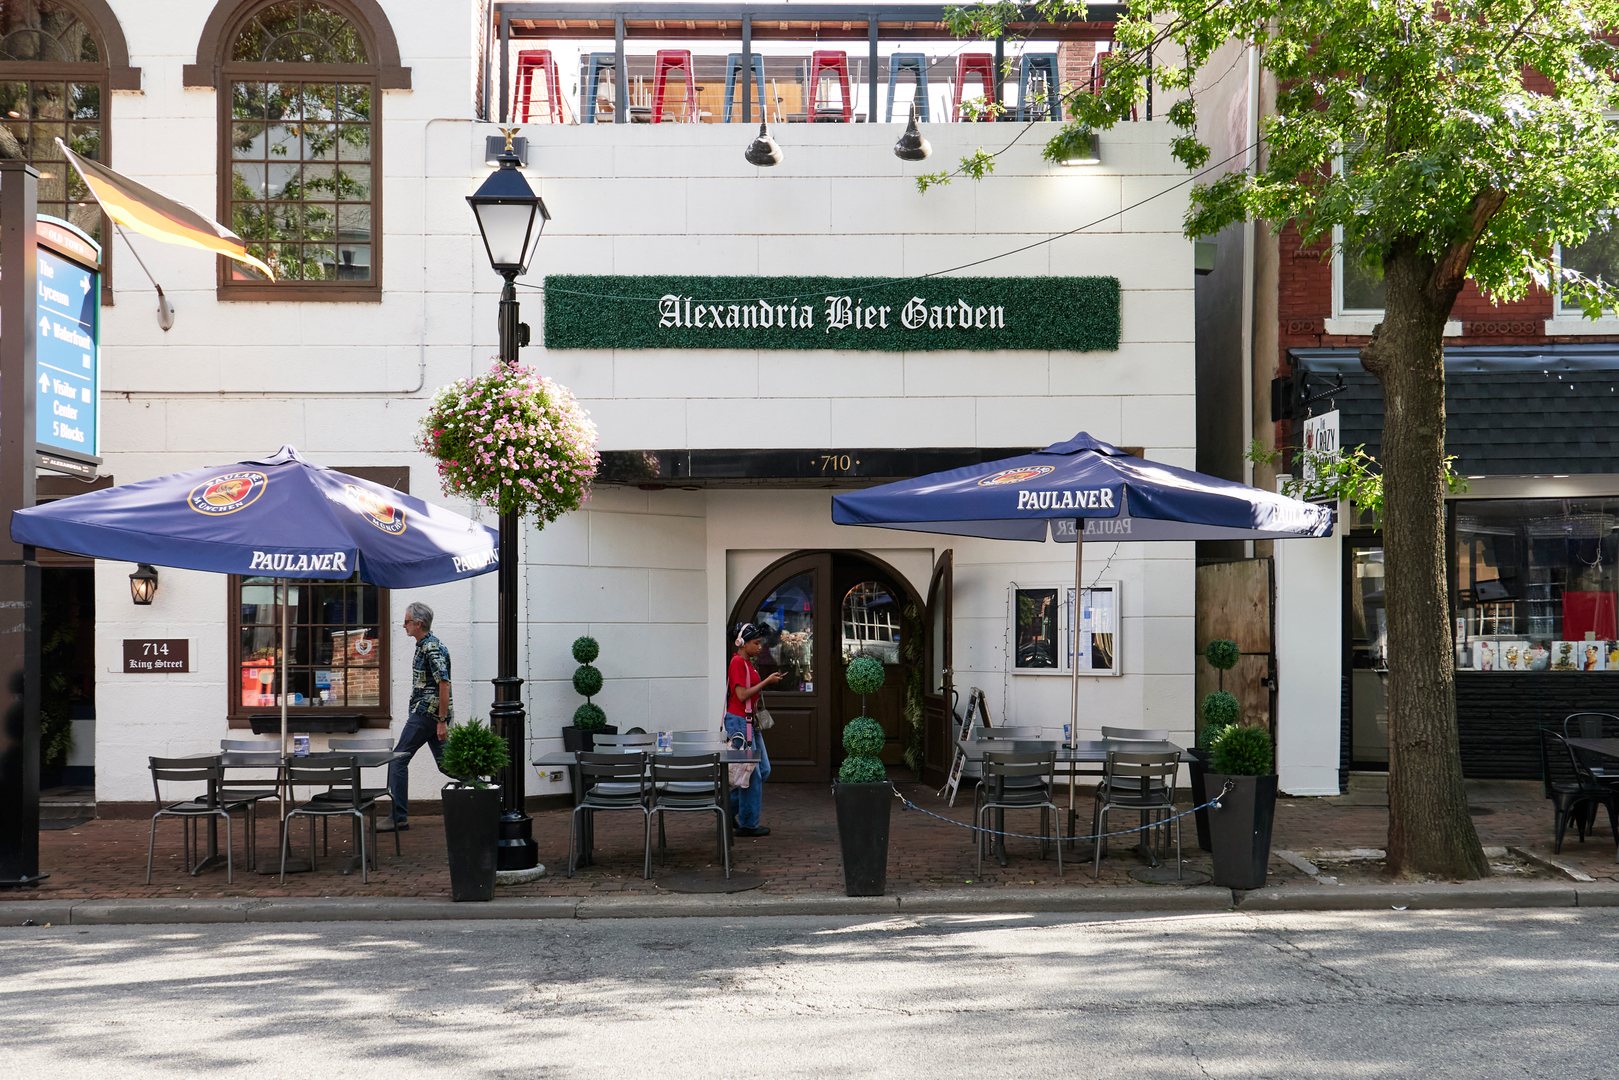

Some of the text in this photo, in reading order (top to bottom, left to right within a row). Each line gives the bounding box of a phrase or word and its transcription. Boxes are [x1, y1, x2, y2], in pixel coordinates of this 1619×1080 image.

[40, 259, 54, 279] The
[39, 281, 69, 306] Lyceum
[658, 294, 1006, 334] Alexandria Bier Garden
[53, 322, 91, 350] Waterfront
[53, 378, 77, 399] Visitor
[53, 400, 78, 420] Center
[53, 421, 84, 443] 5 Blocks
[1315, 428, 1335, 454] CRAZY
[821, 454, 851, 471] 710
[1017, 488, 1115, 510] PAULANER
[249, 551, 347, 571] PAULANER
[142, 643, 169, 656] 714
[129, 659, 183, 669] King Street
